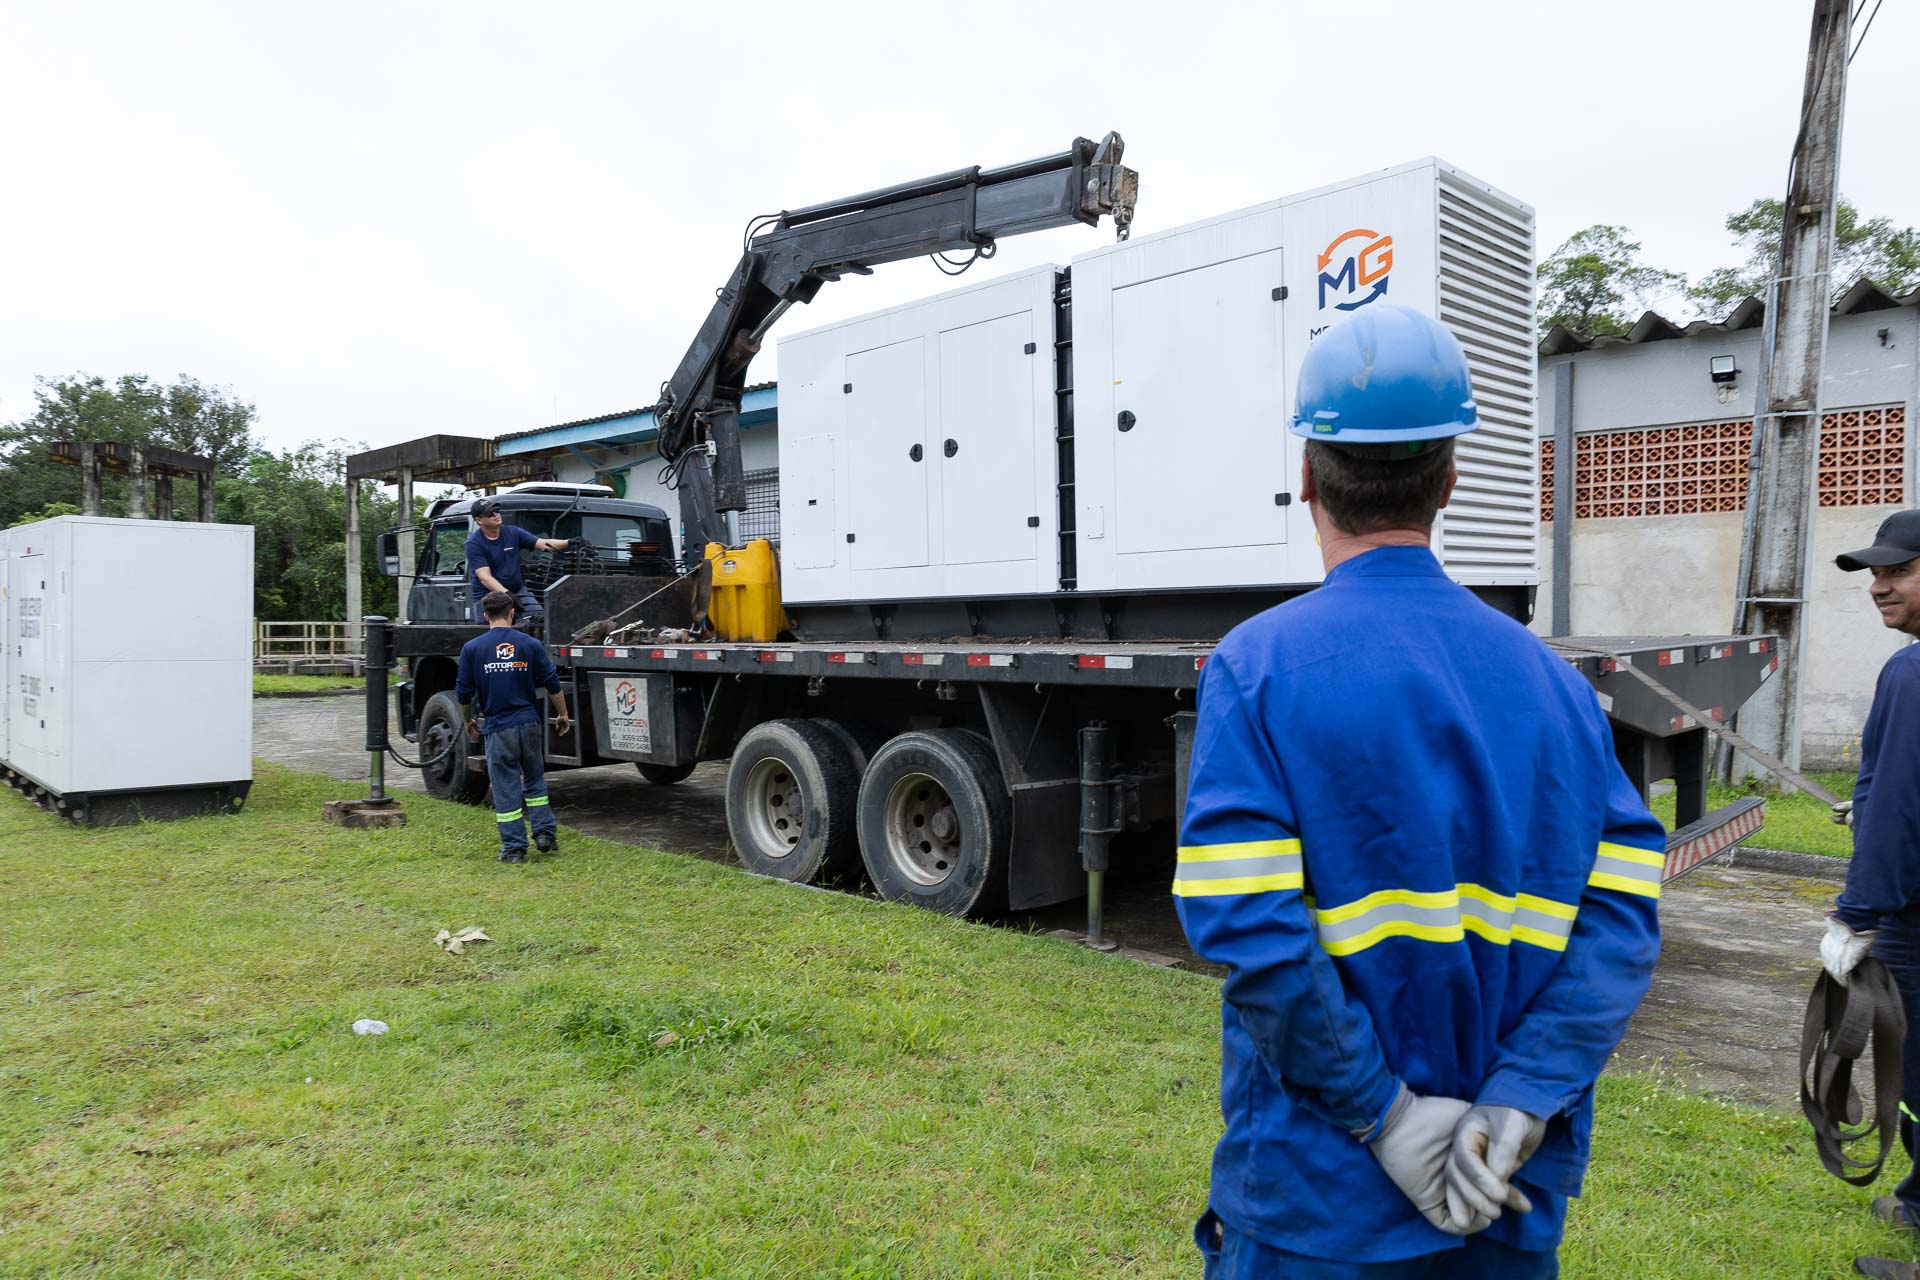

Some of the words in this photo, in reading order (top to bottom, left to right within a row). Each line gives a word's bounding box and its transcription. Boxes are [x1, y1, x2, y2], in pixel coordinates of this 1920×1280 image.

[1318, 235, 1393, 311] MG
[496, 644, 515, 659] MG
[484, 661, 528, 670] MOTORGEN
[616, 687, 637, 712] MG
[609, 717, 648, 728] MOTORGEN
